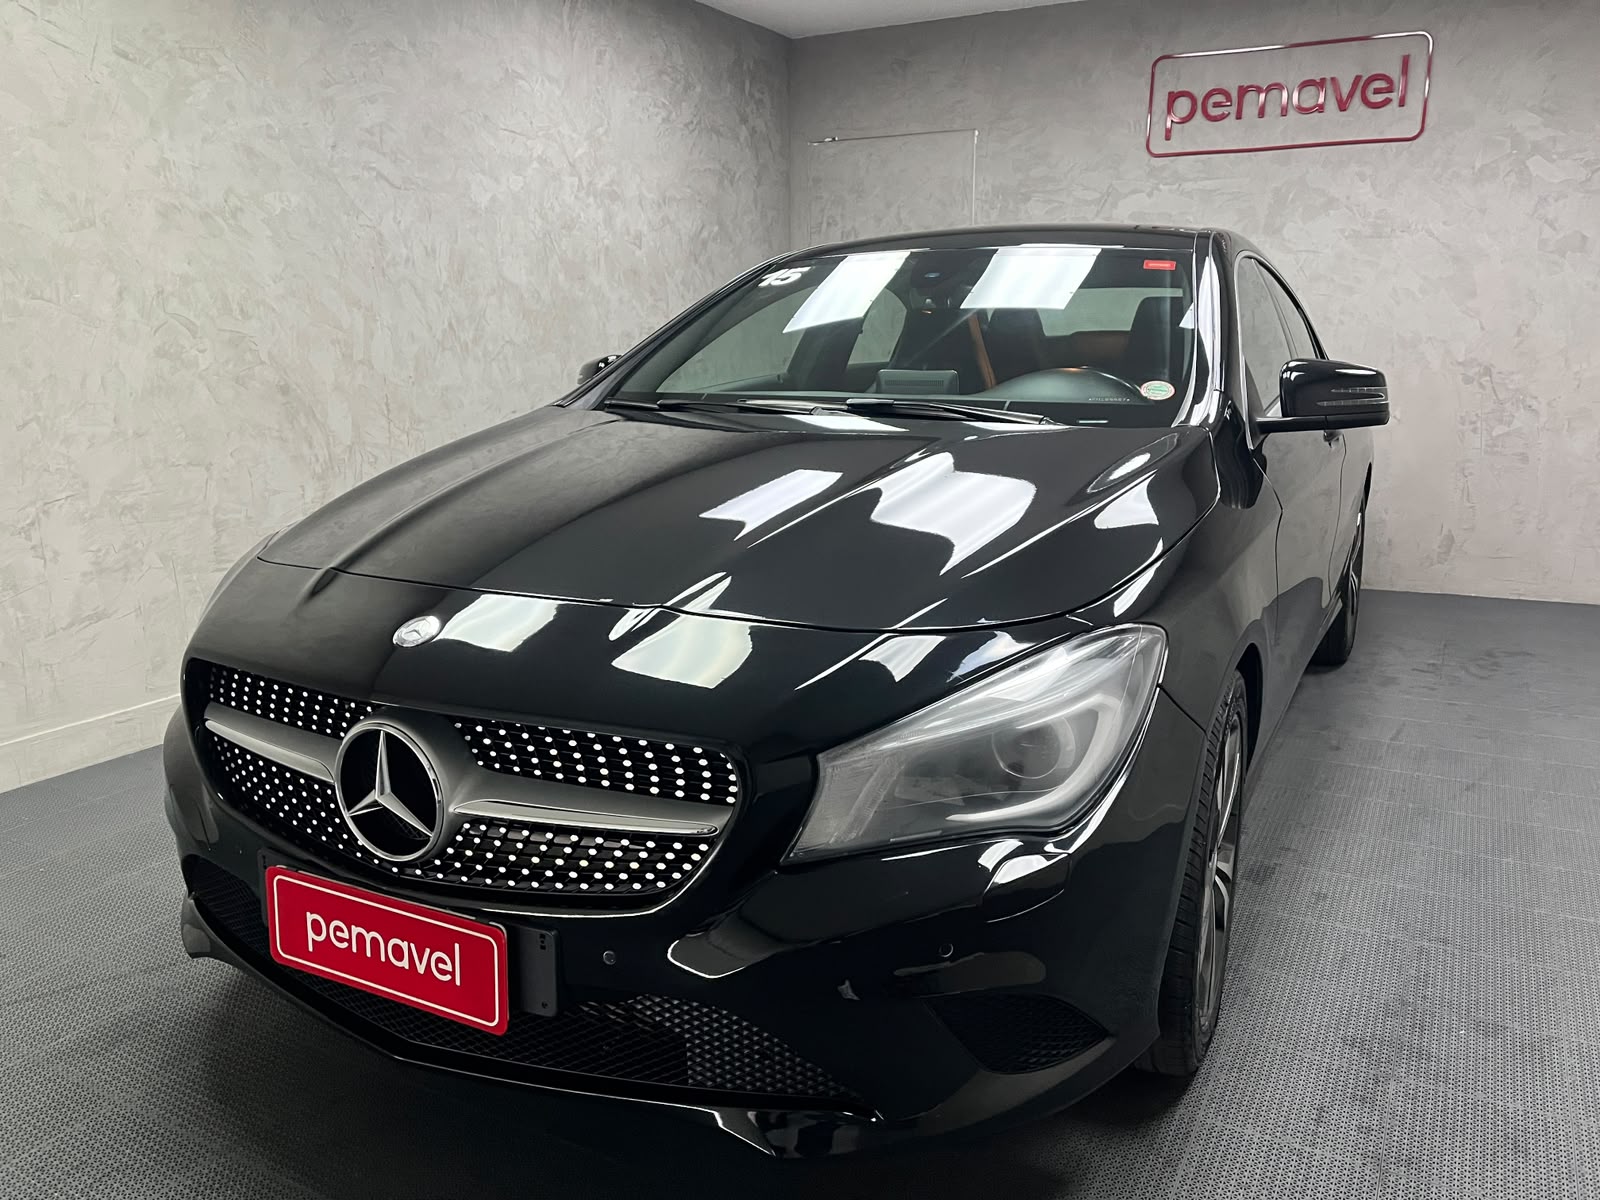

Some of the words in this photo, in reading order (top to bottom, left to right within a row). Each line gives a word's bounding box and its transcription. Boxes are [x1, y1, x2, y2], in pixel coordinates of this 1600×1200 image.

[1164, 54, 1410, 141] pemavel
[758, 266, 812, 286] 15
[306, 911, 461, 986] pemavel
